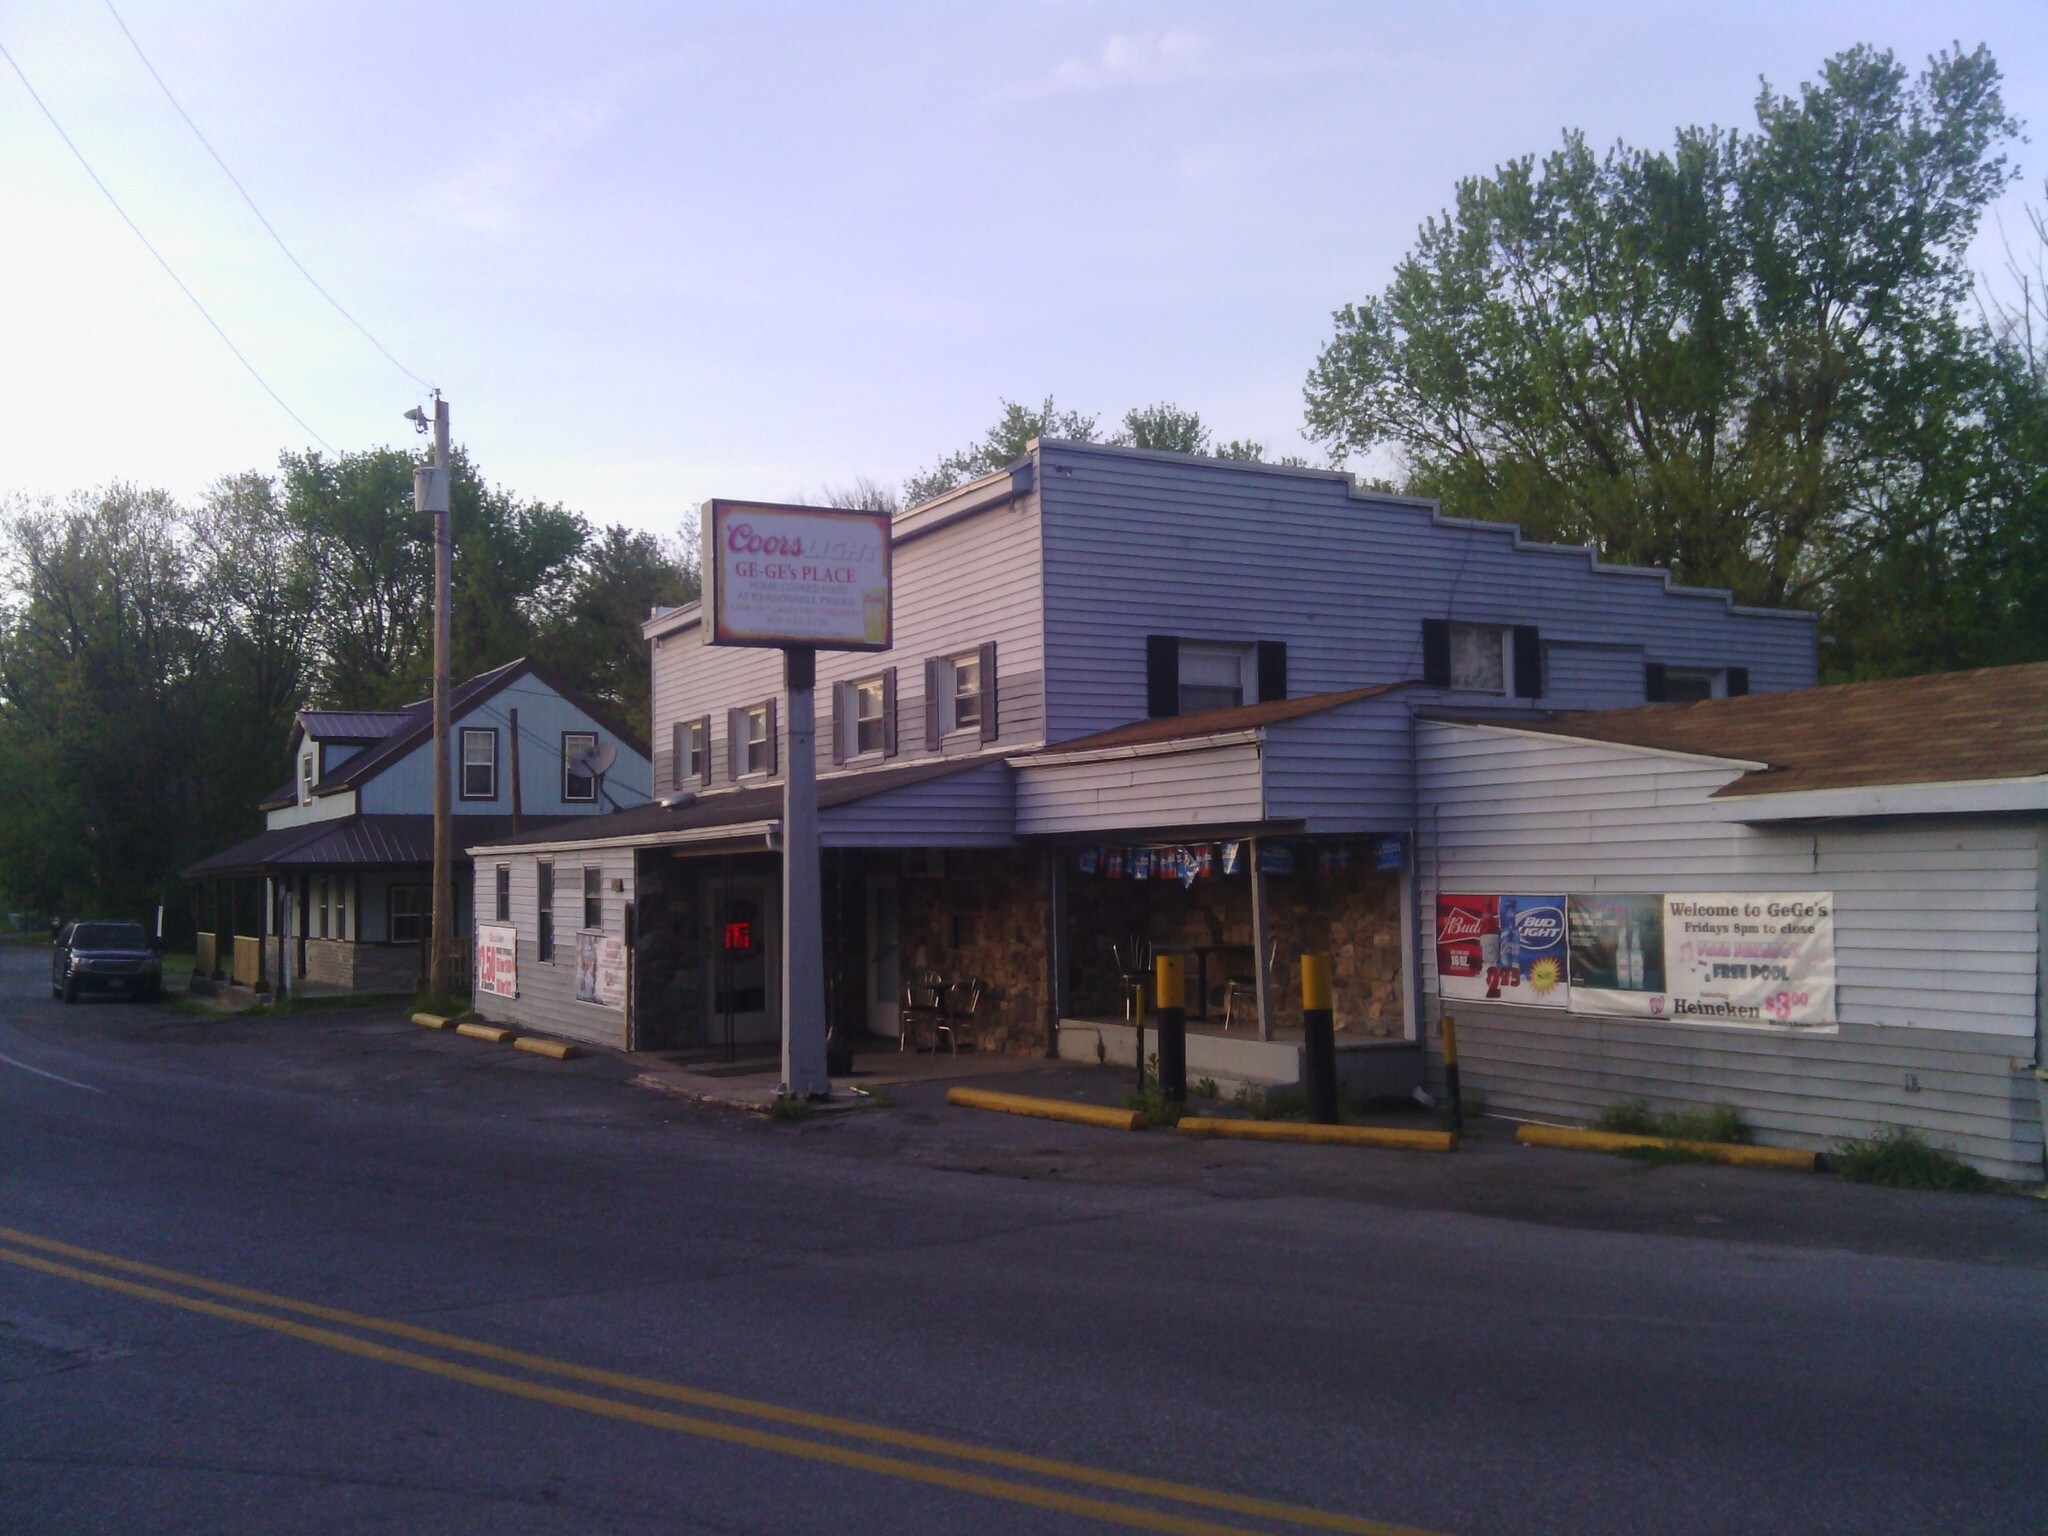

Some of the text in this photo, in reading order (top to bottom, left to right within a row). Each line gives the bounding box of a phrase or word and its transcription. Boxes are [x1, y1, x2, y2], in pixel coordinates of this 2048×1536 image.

[727, 523, 804, 557] Coors
[801, 565, 857, 584] PLACE
[1669, 901, 1828, 917] Welcome to GeGe's
[1518, 926, 1560, 937] LIGHT
[1684, 921, 1814, 936] Fridays 8pm to close
[1712, 963, 1790, 982] FREE POOL
[1673, 998, 1760, 1019] Heineken
